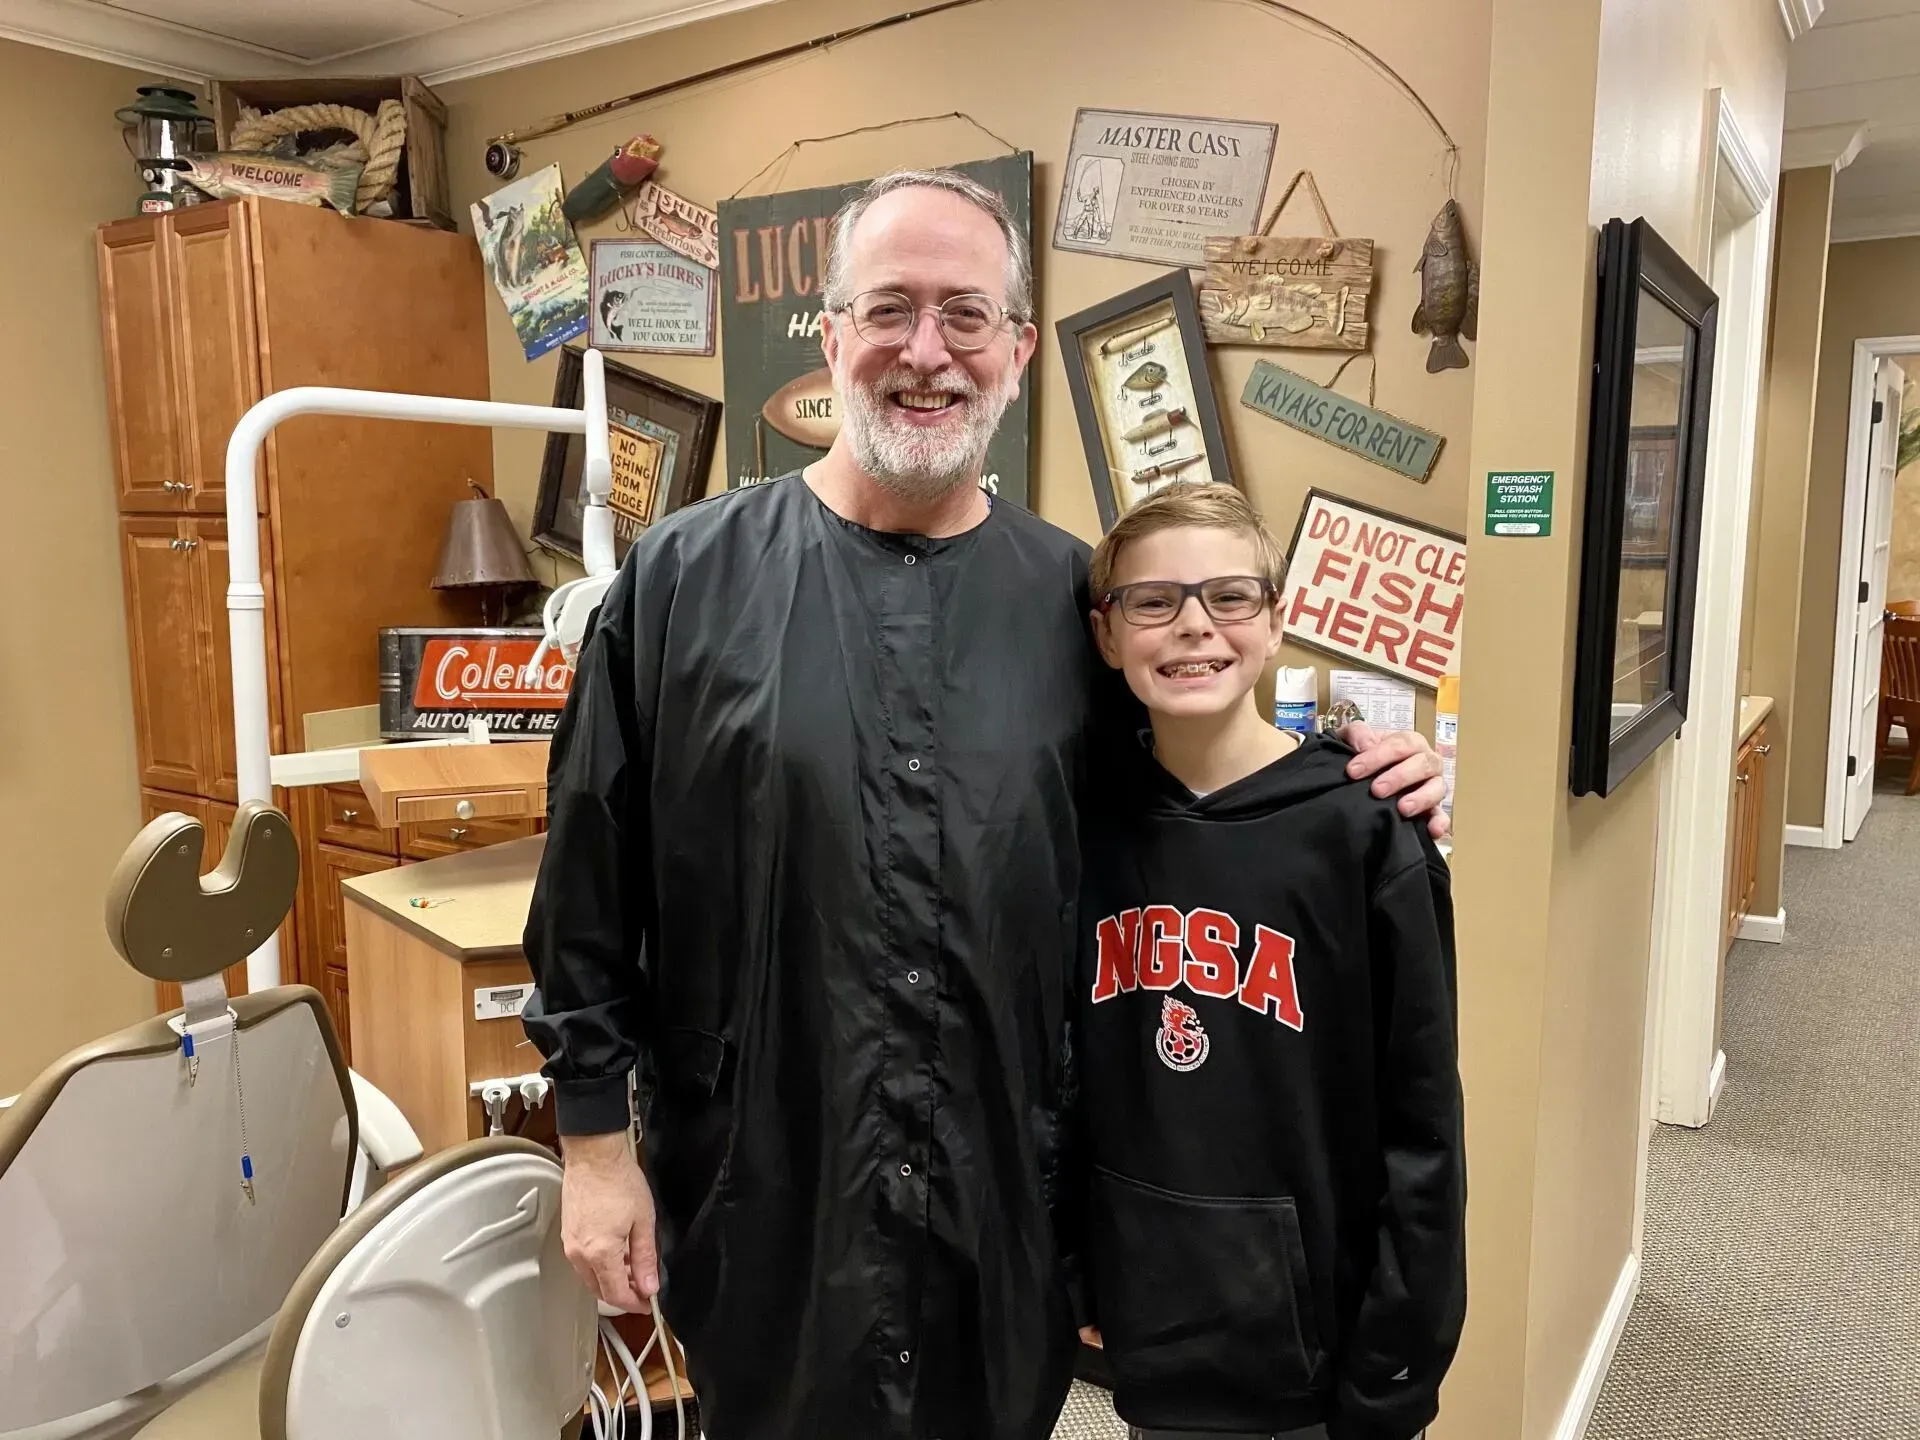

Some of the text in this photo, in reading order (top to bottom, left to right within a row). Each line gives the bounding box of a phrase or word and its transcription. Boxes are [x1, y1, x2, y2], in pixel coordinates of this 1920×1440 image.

[1096, 127, 1241, 158] MASTER CAST
[1130, 152, 1200, 169] STEEL FISHING RODS
[231, 163, 304, 187] WELCOME
[1161, 176, 1216, 191] CHOSEN BY
[1130, 185, 1244, 208] EXPERIENCED ANGLERS
[1138, 199, 1230, 219] FOR OVER 50 YEARS
[648, 220, 702, 257] EXPEDITIONS
[620, 250, 634, 259] FISH
[599, 261, 704, 291] LUCKY'S LURES
[1231, 258, 1334, 277] WELCOME
[628, 318, 653, 328] WE'LL
[655, 319, 681, 329] HOOK
[632, 331, 650, 341] YOU
[651, 332, 675, 343] COOK
[795, 397, 832, 419] SINCE
[1254, 375, 1426, 466] KAYAKS FOR RENT
[619, 438, 637, 456] NO
[612, 452, 650, 479] ISHING
[1491, 475, 1551, 484] EMERGENCY
[1497, 485, 1543, 494] EYEWASH
[609, 487, 643, 512] RIDGE
[1500, 494, 1539, 503] STATION
[1308, 507, 1351, 546] DO
[1352, 522, 1417, 567] NOT
[1311, 548, 1464, 635] FISH
[1288, 586, 1455, 679] HERE
[435, 646, 568, 700] Colema
[1092, 905, 1304, 1032] NGSA
